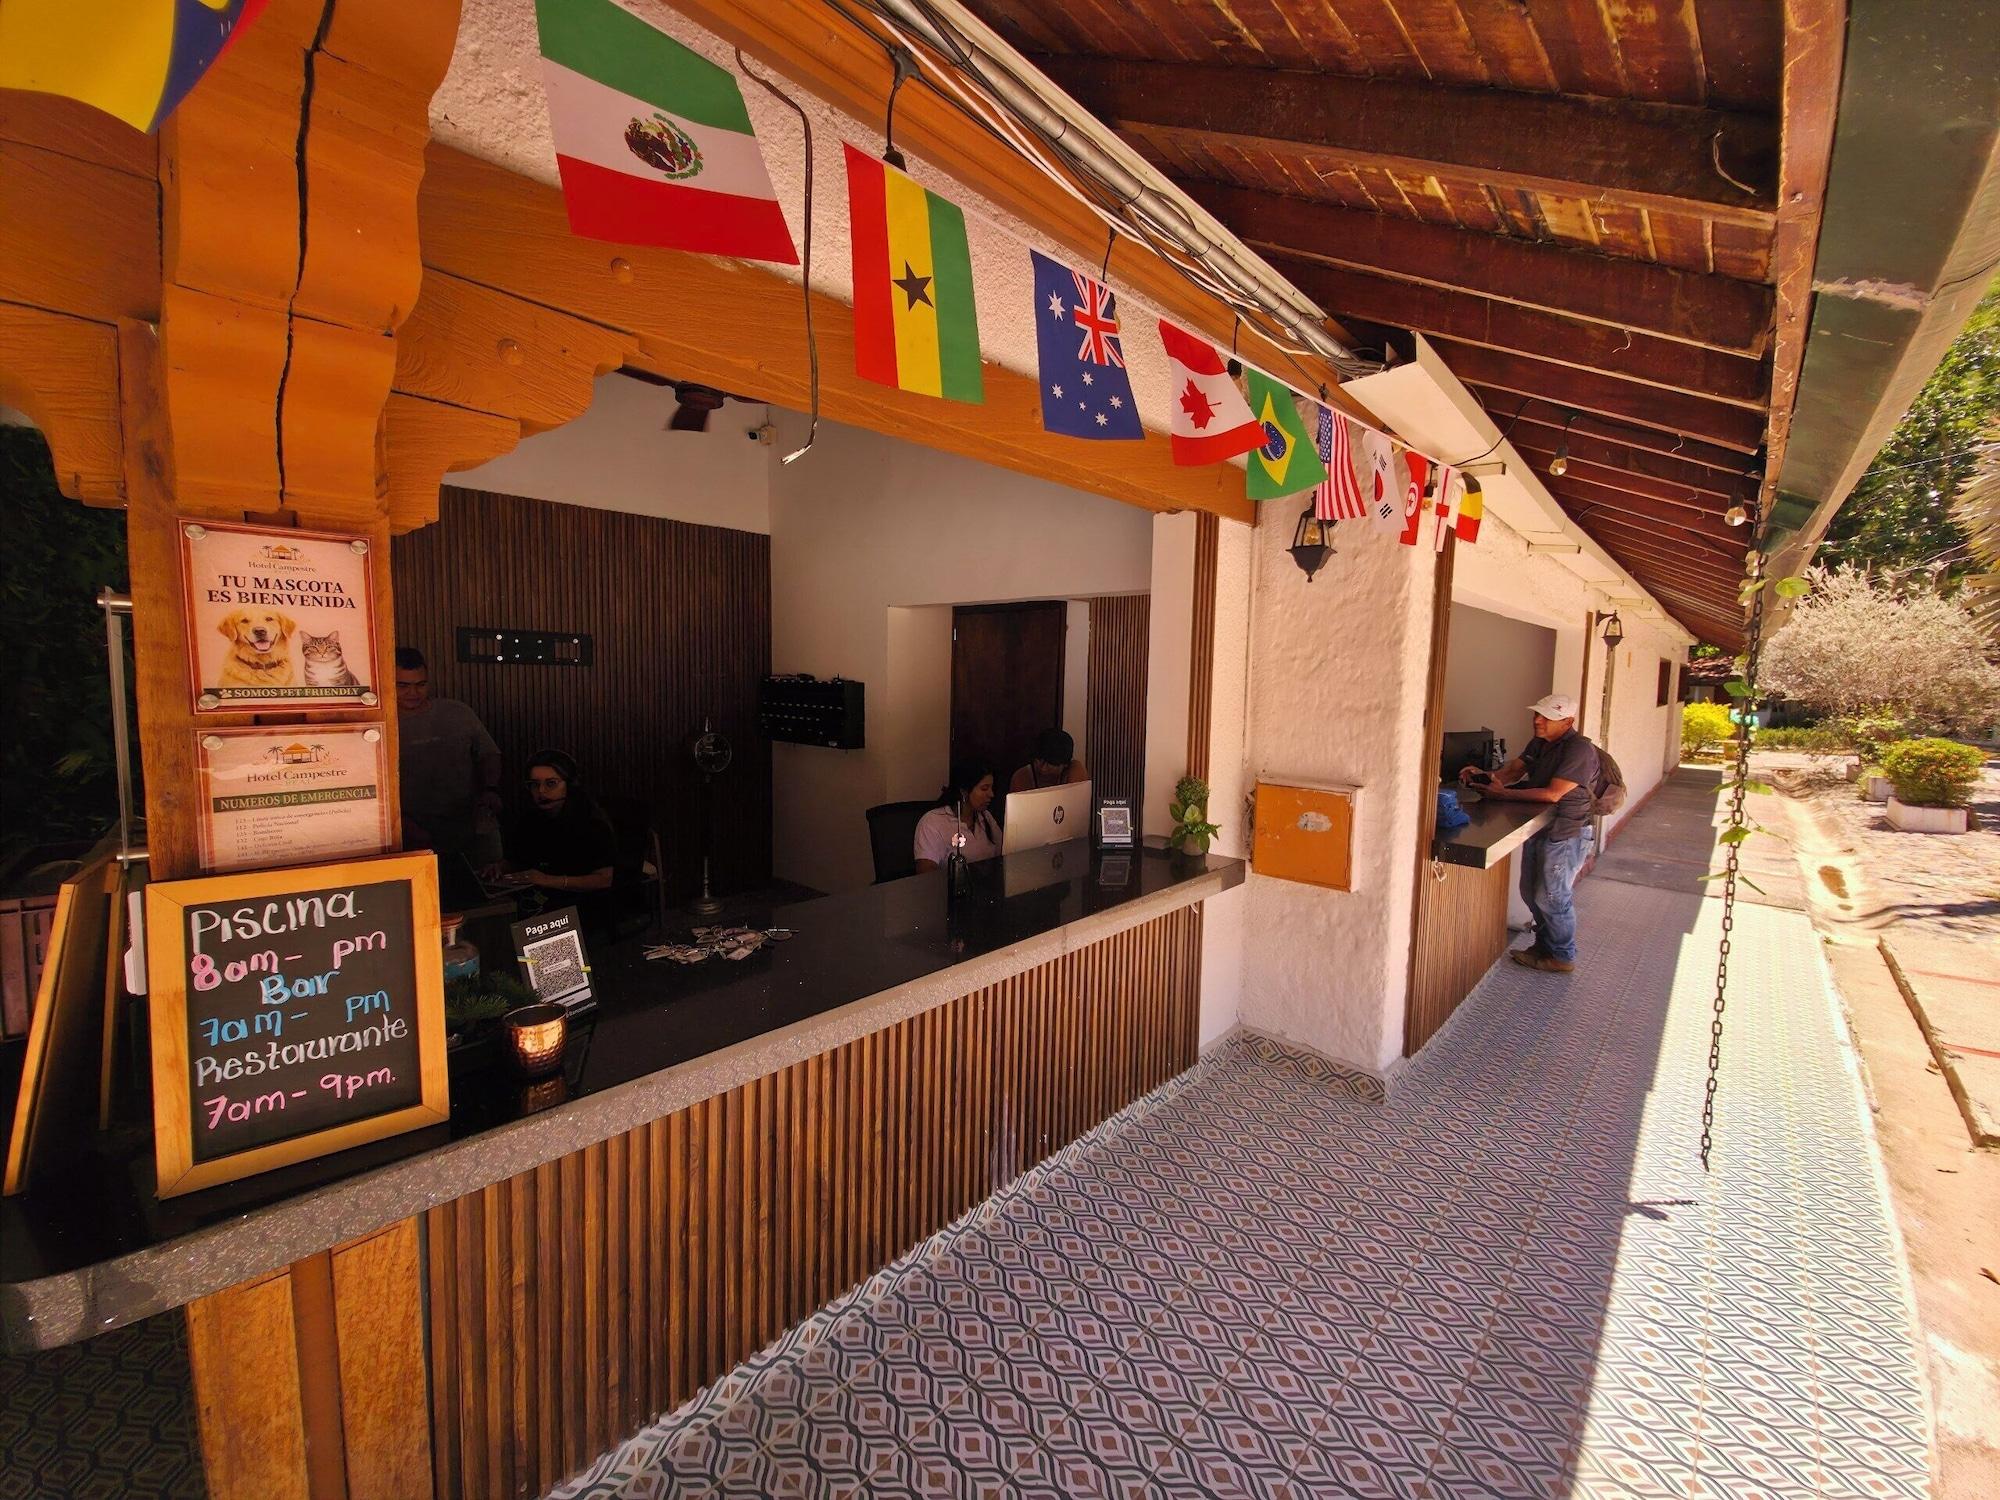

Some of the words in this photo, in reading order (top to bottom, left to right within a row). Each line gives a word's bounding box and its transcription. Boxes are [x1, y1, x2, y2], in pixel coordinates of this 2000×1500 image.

[248, 561, 272, 570] Hotel
[273, 563, 317, 574] Campestre
[219, 575, 247, 588] TU
[253, 576, 344, 594] MASCOTA
[207, 589, 232, 603] ES
[236, 591, 356, 609] BIENVENIDA
[234, 688, 277, 698] SOMOS
[280, 687, 301, 697] PET
[305, 687, 360, 697] FRIENDLY
[247, 771, 281, 783] Hotel
[284, 768, 348, 780] Campestre
[220, 796, 281, 810] NUMEROS
[283, 794, 299, 804] DE
[301, 788, 371, 803] EMERGENCIA
[525, 923, 548, 937] Paga
[550, 915, 569, 930] aquí
[333, 930, 387, 969] pm
[260, 971, 340, 1005] Bar
[346, 990, 390, 1023] pm
[195, 1014, 408, 1087] Restaurante
